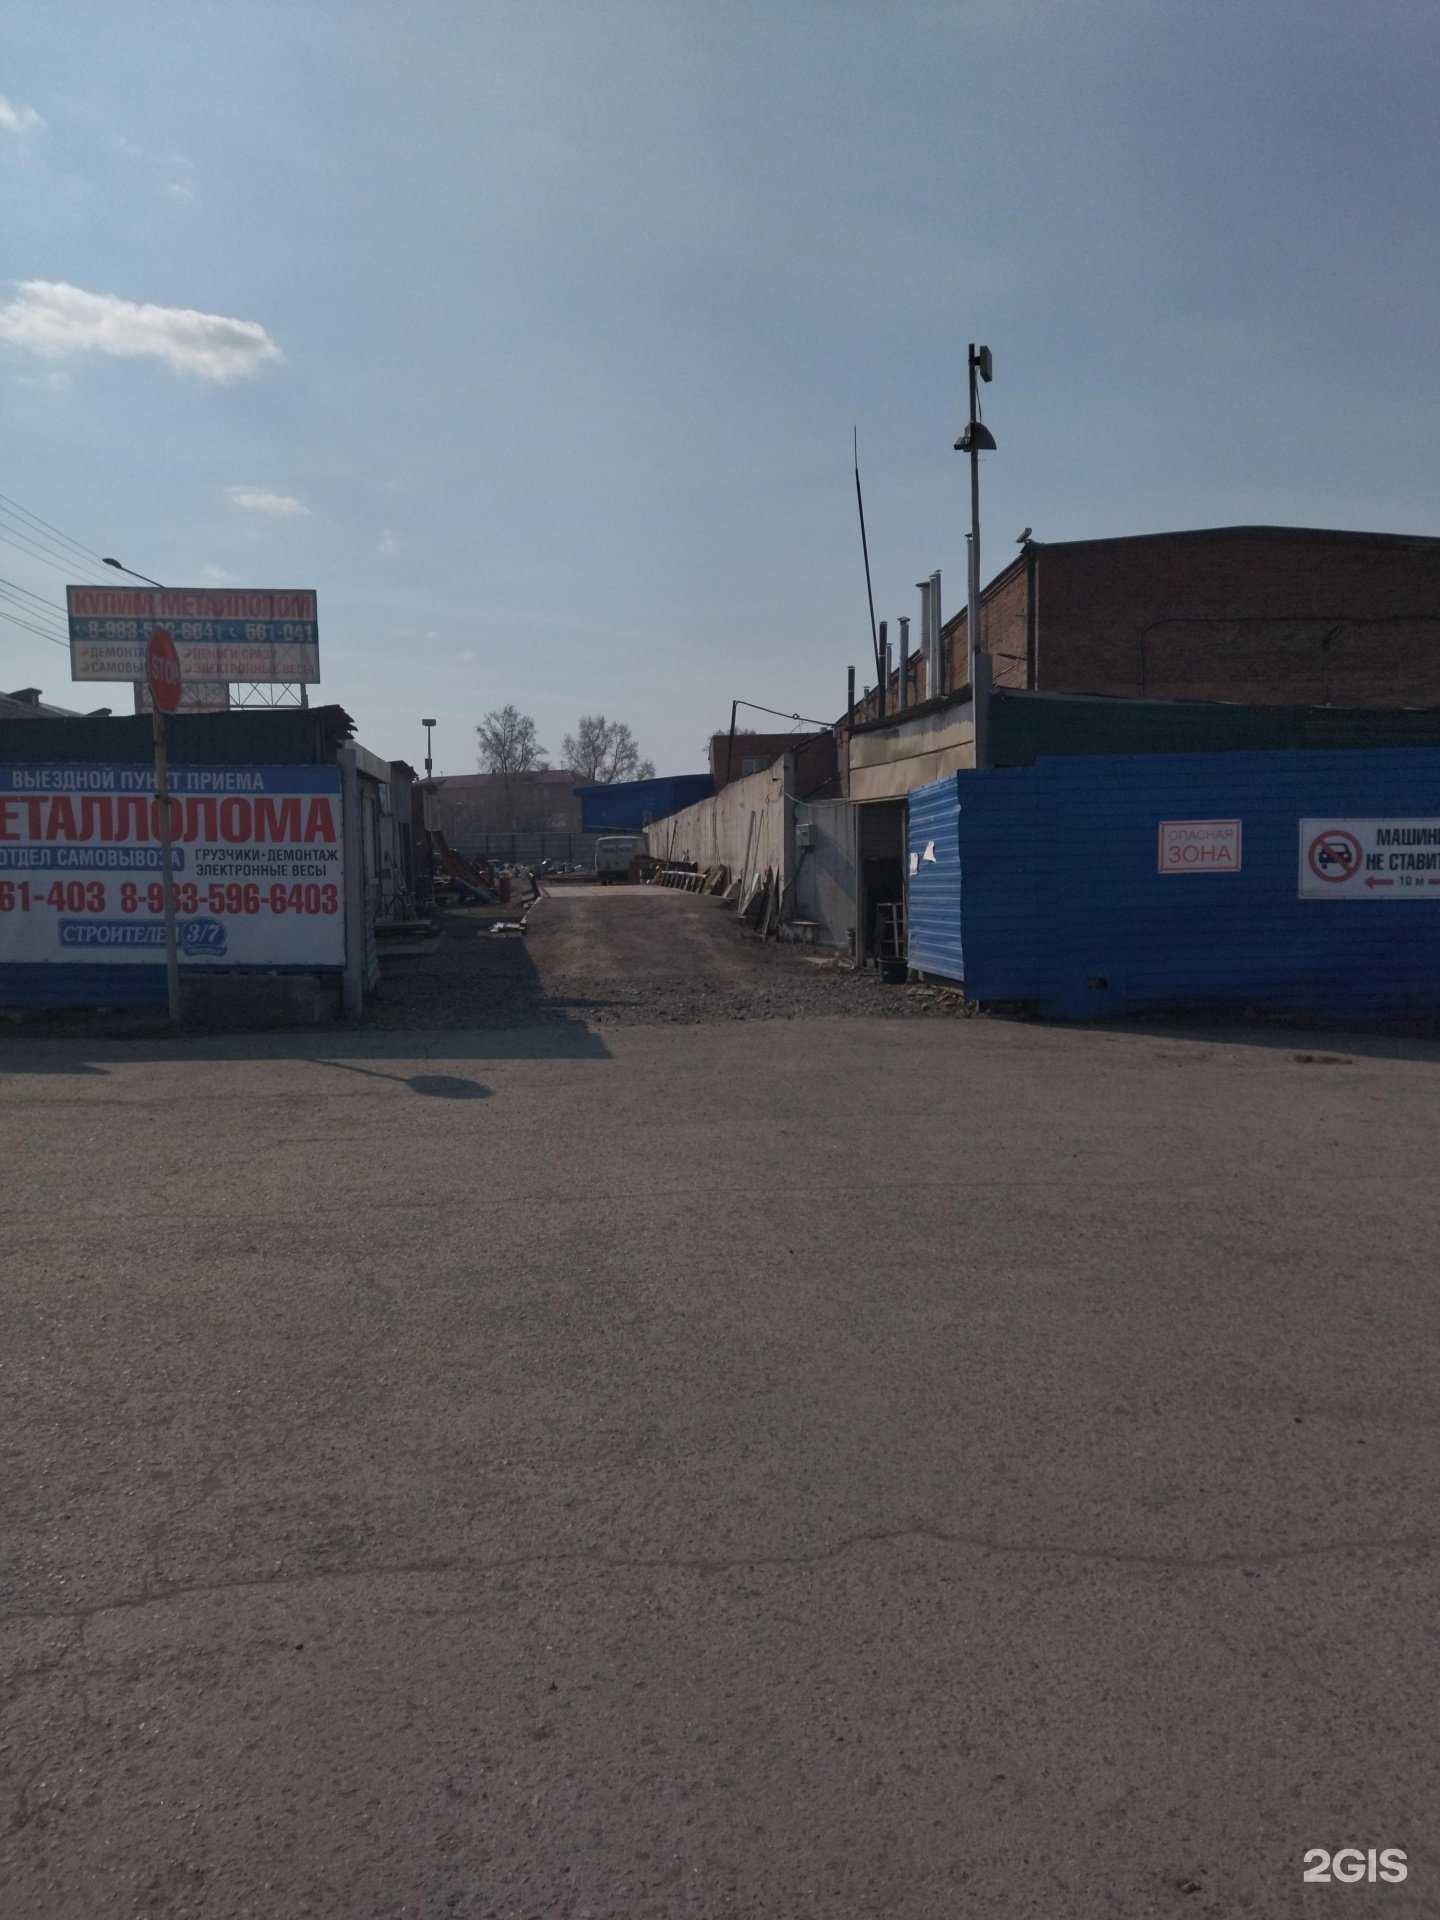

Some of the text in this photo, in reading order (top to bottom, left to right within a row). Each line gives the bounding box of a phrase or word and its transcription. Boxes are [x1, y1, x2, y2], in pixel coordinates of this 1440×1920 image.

[89, 647, 146, 659] ДЕМОНТА
[12, 768, 264, 790] ВЫЕЗДНОЙ ПУНТ ПРИЕМА
[1376, 828, 1440, 846] МАШИН
[1168, 846, 1232, 863] ЗОНА
[1366, 853, 1385, 870] НЕ
[196, 864, 326, 877] ЭЛЕКТРОННЫЕ ВЕСЫ
